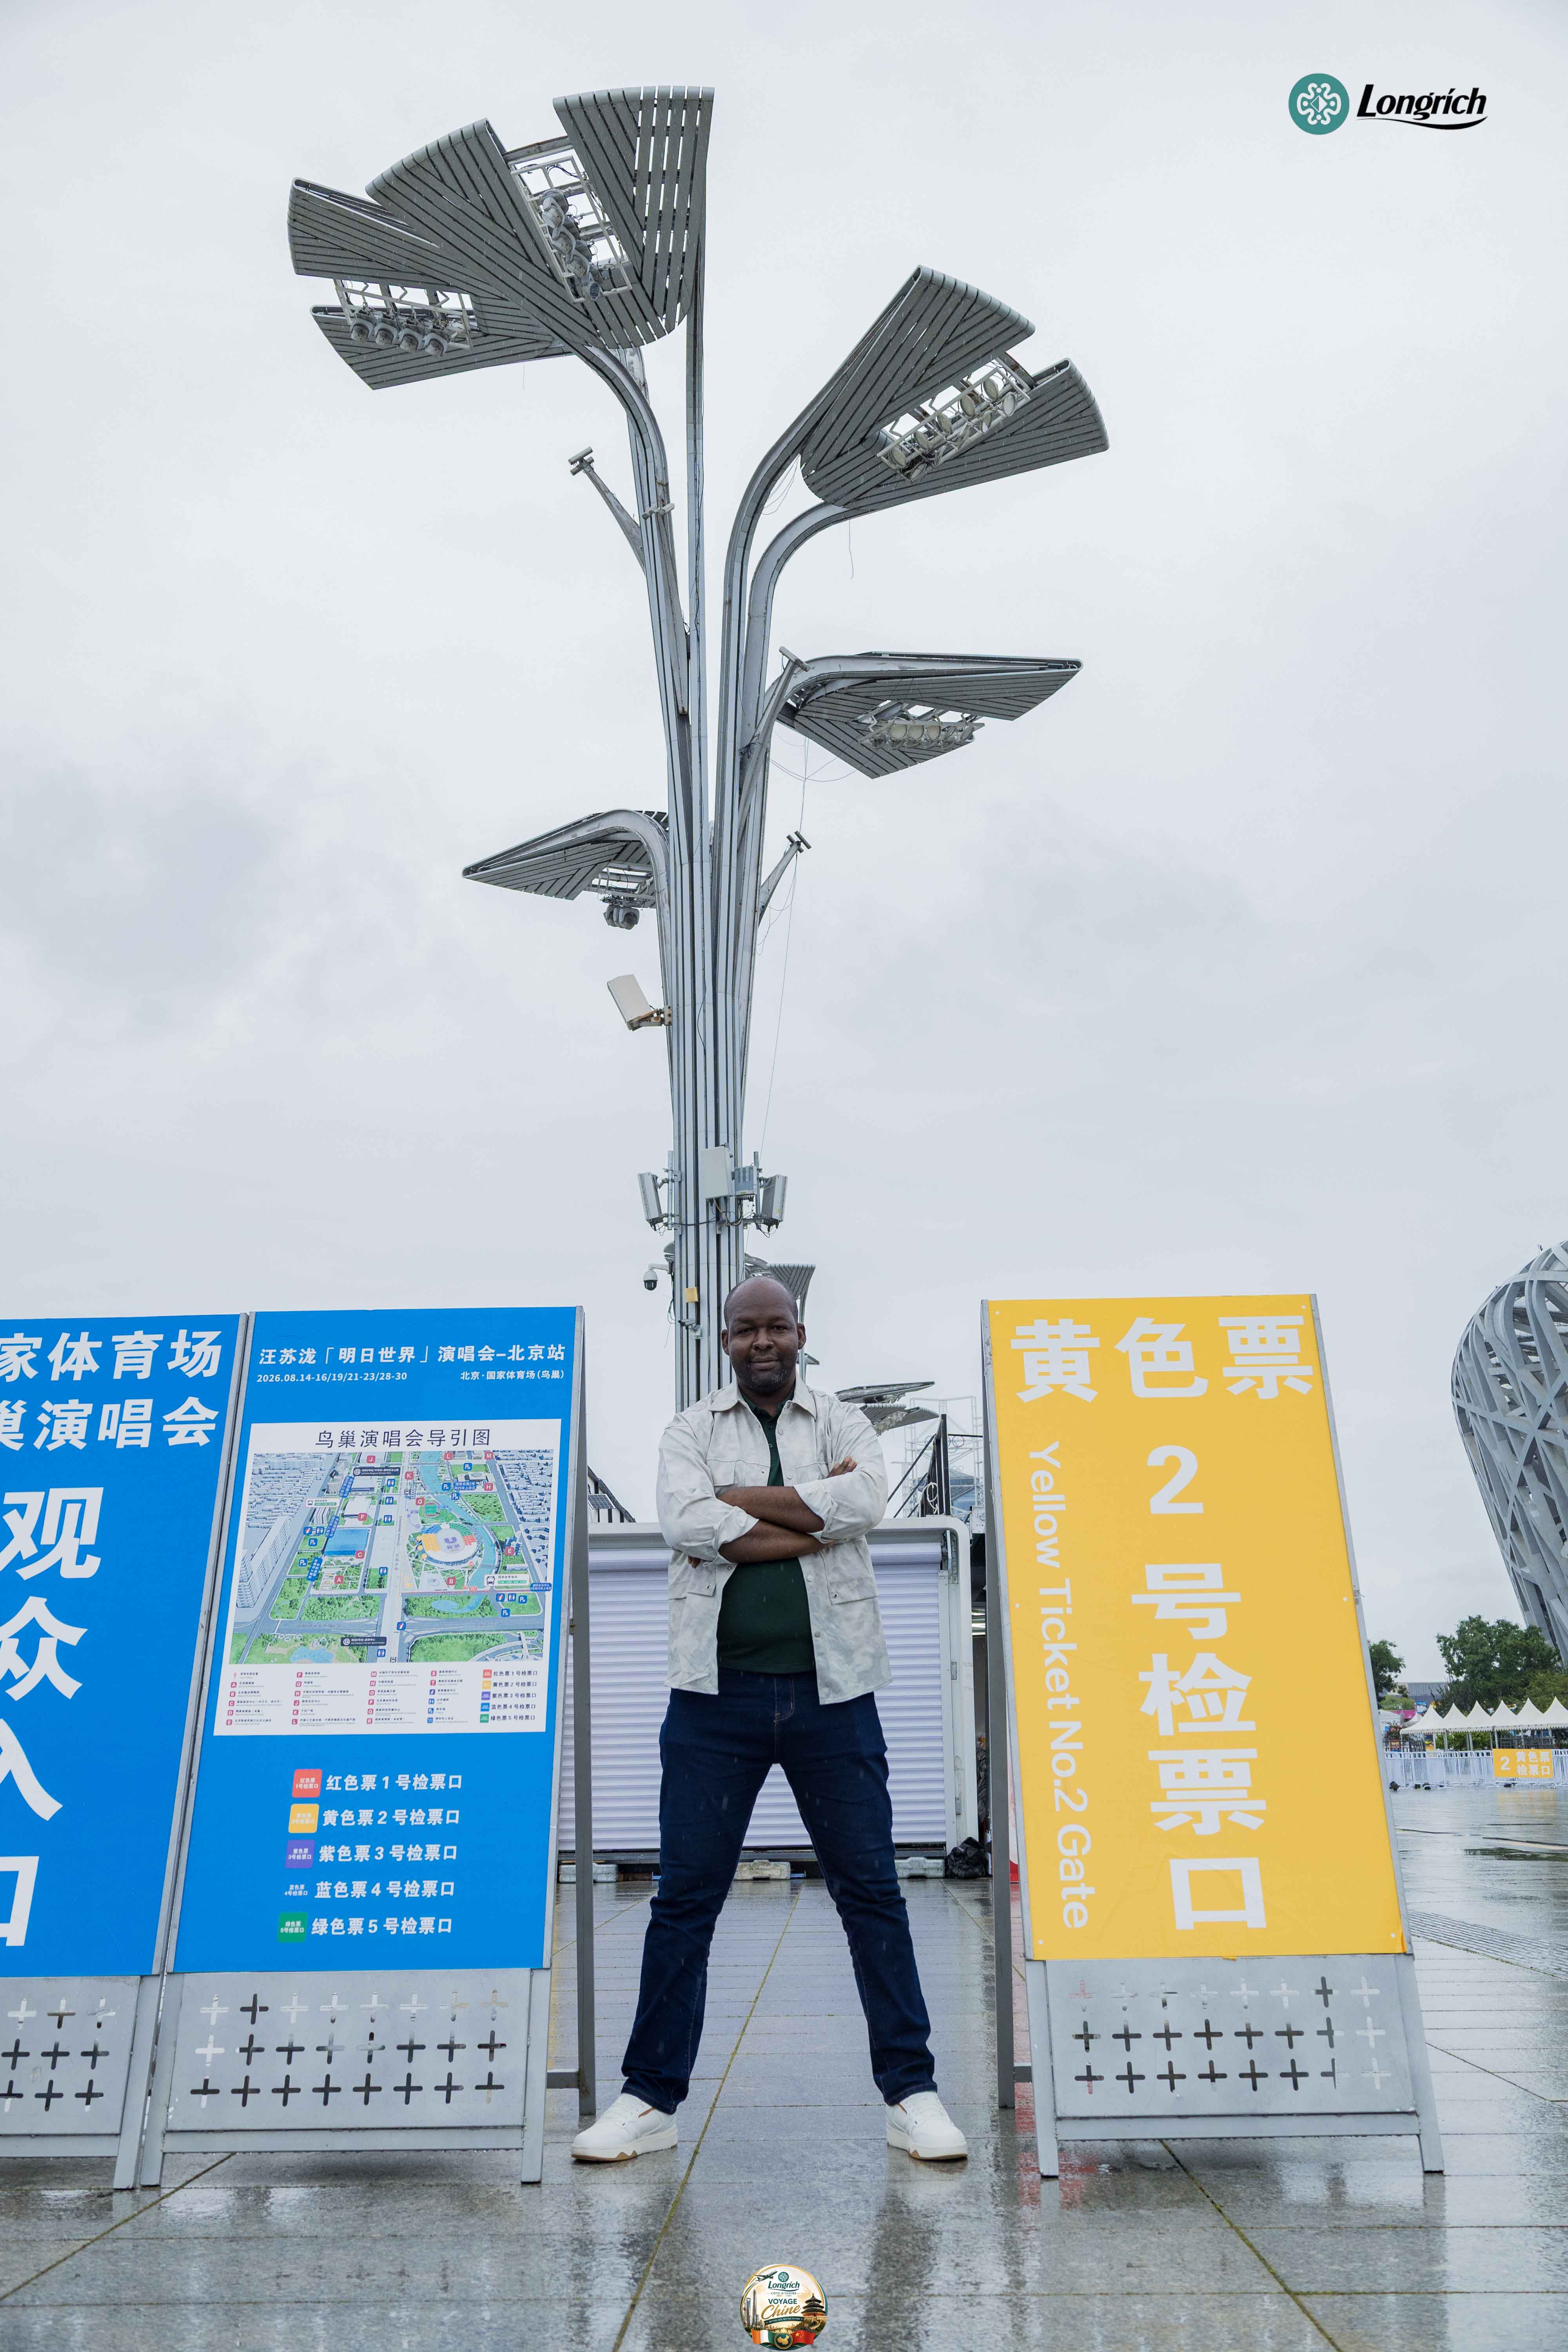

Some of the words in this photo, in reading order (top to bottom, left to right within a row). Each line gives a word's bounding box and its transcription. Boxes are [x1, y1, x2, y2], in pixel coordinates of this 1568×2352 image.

[0, 1329, 221, 1382] 家体育场
[257, 1372, 407, 1382] 2026.08.14-16/19/21-23/28-30
[1010, 1315, 1314, 1403] 黄色票
[315, 1429, 491, 1448] 鸟巢演唱会导引图
[1029, 1441, 1066, 1568] Yellow
[1039, 1578, 1080, 1710] Ticket
[1049, 1721, 1088, 1813] No.2
[1500, 1756, 1511, 1771] 2
[1515, 1751, 1550, 1762] 黄色票
[1517, 1764, 1551, 1775] 检票口
[1057, 1823, 1096, 1928] Gate
